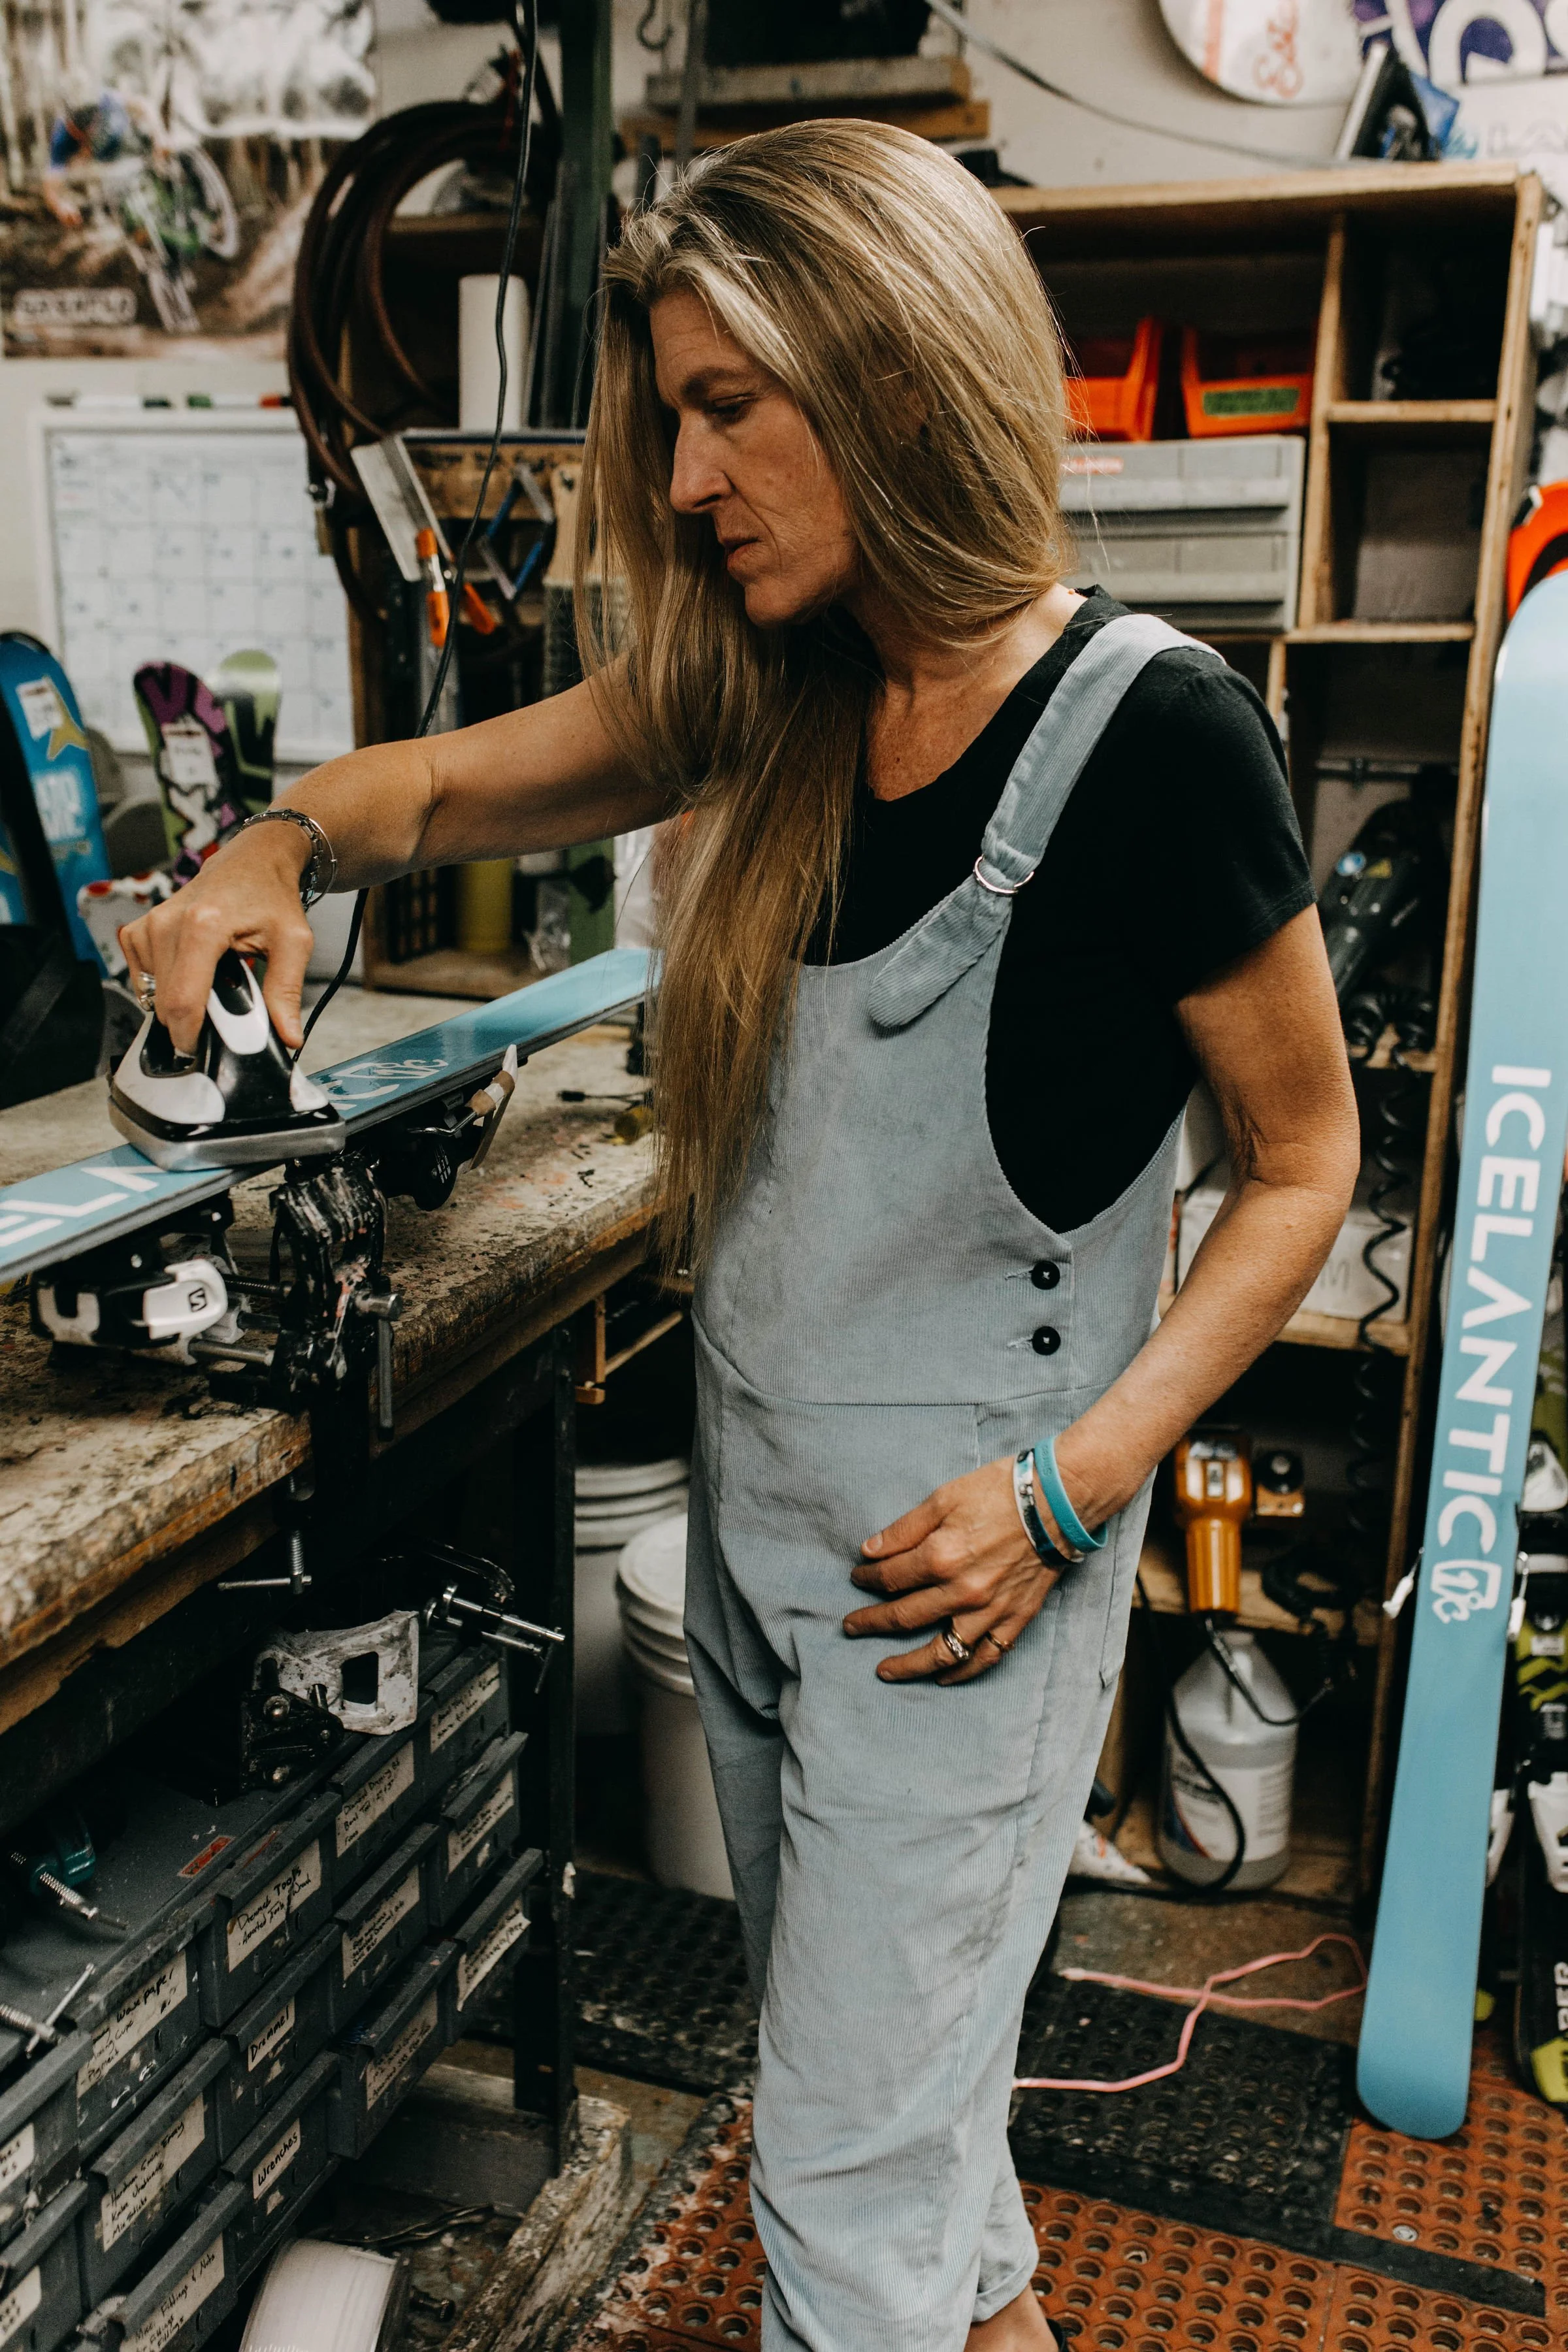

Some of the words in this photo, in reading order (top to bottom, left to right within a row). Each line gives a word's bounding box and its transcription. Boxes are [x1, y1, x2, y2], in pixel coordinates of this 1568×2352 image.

[1438, 1064, 1552, 1555] ICELANTIC
[116, 1999, 140, 2023] Wax
[257, 2132, 298, 2187] Wrenches
